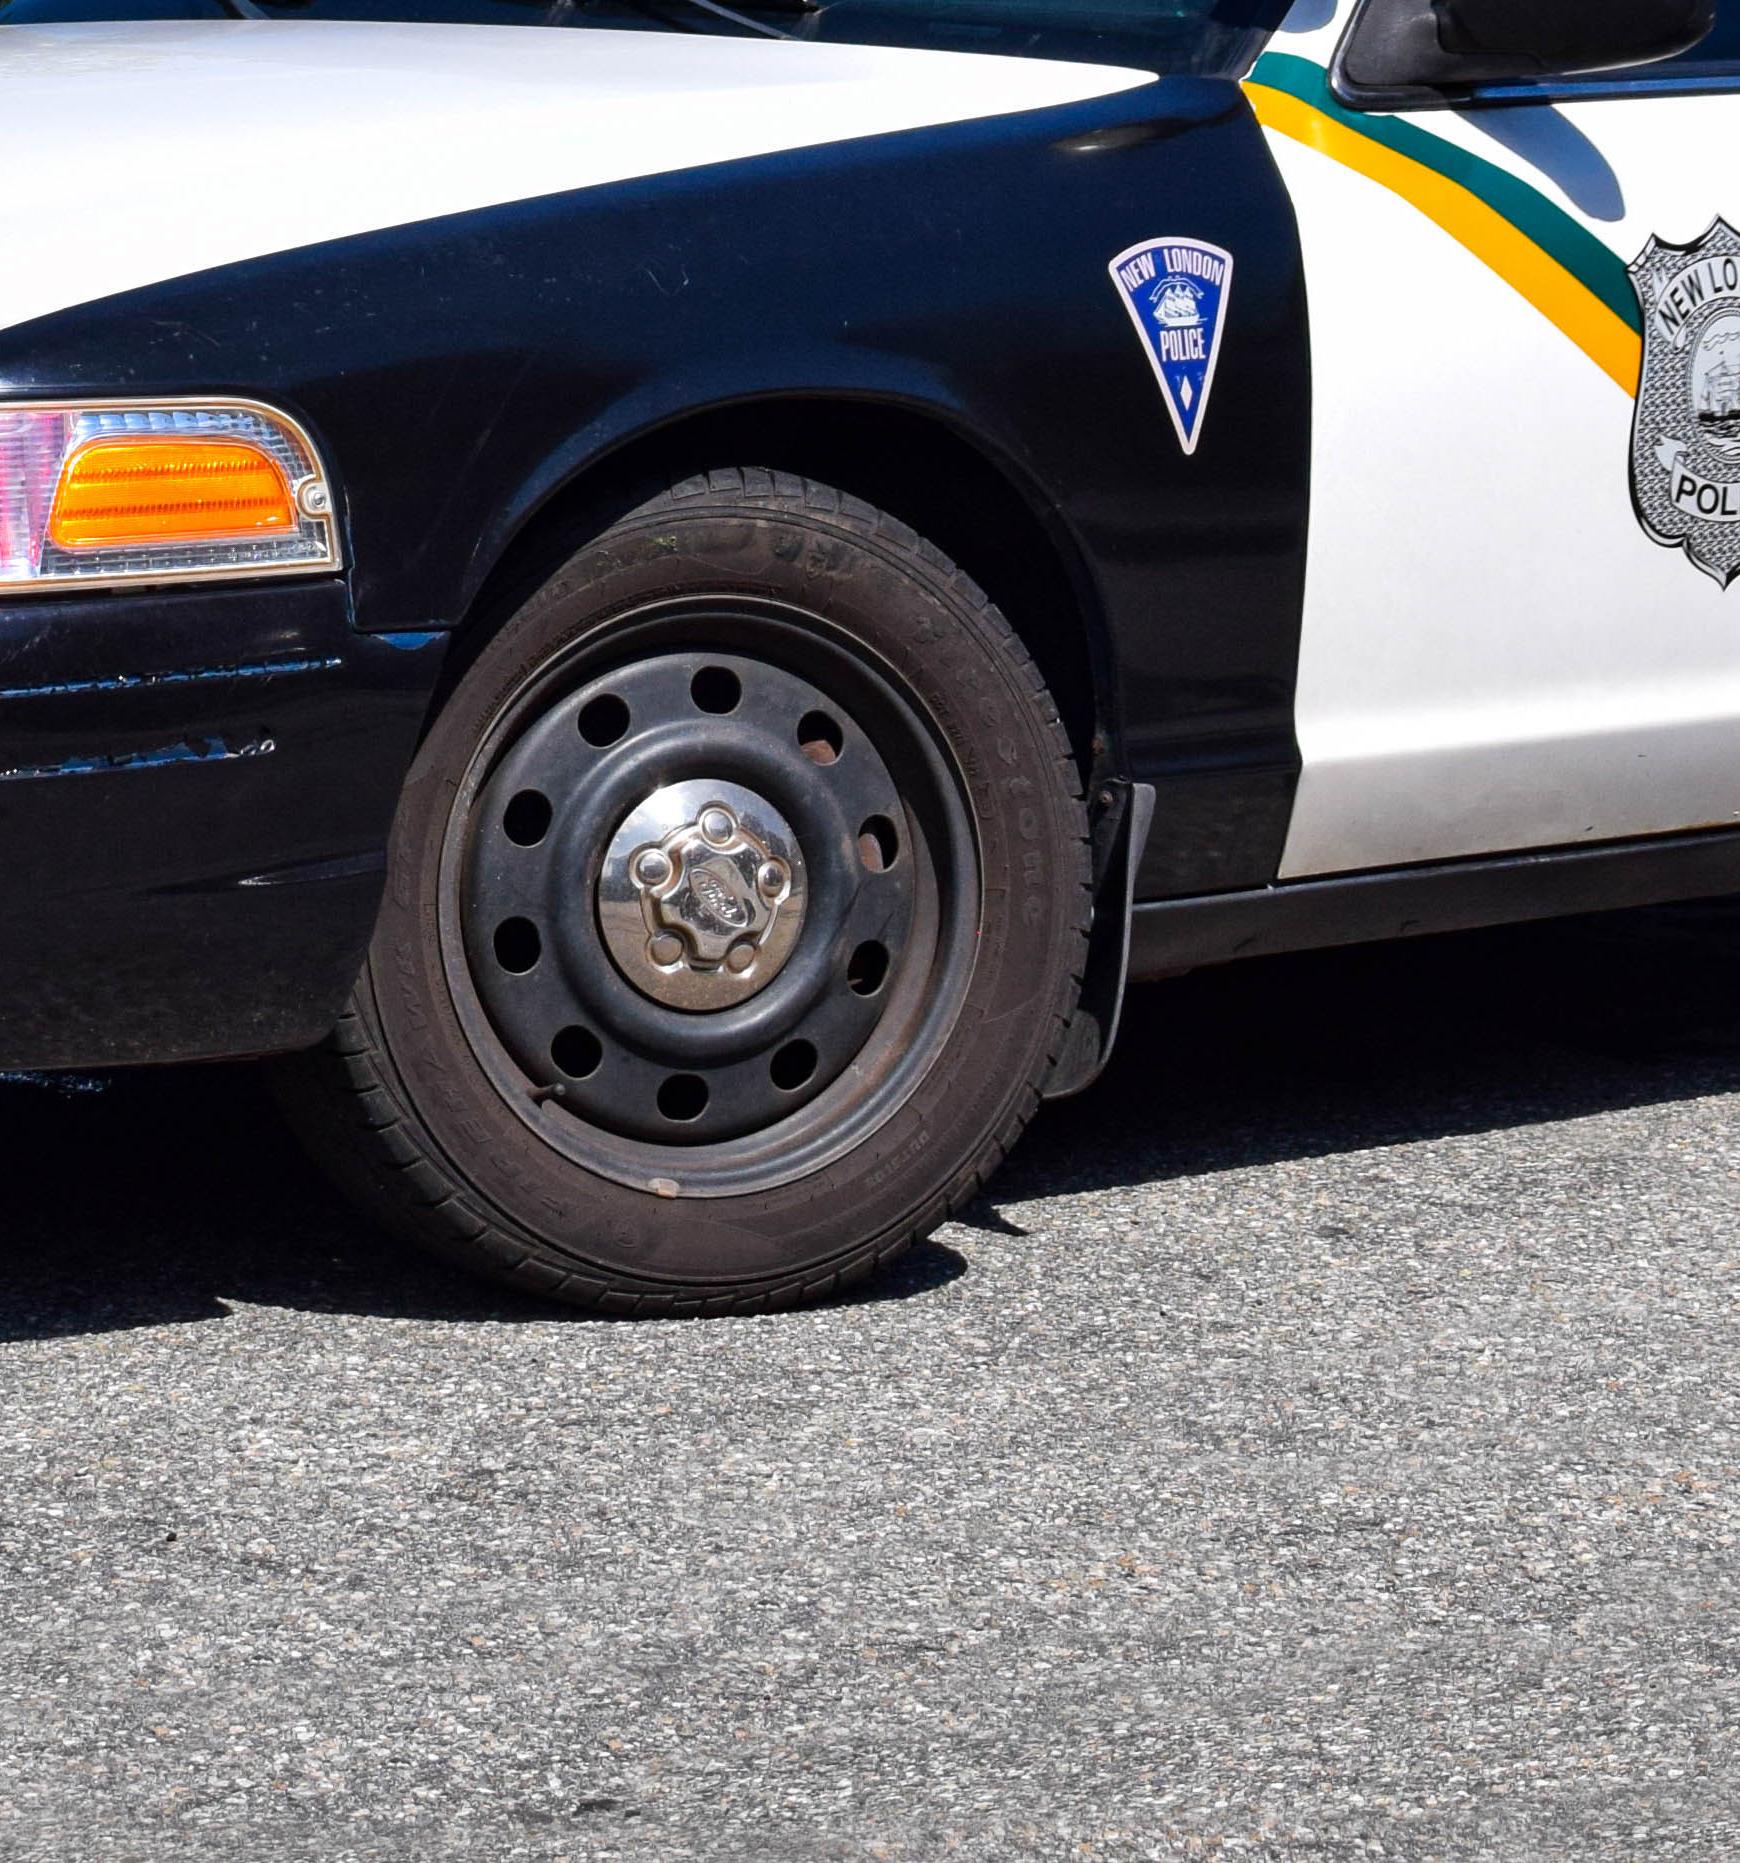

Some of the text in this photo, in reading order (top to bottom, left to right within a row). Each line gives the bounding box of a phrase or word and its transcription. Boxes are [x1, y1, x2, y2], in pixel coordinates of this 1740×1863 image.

[1120, 247, 1224, 292] NEW LONDON
[1659, 269, 1705, 334] NEW
[1160, 328, 1206, 362] POLICE
